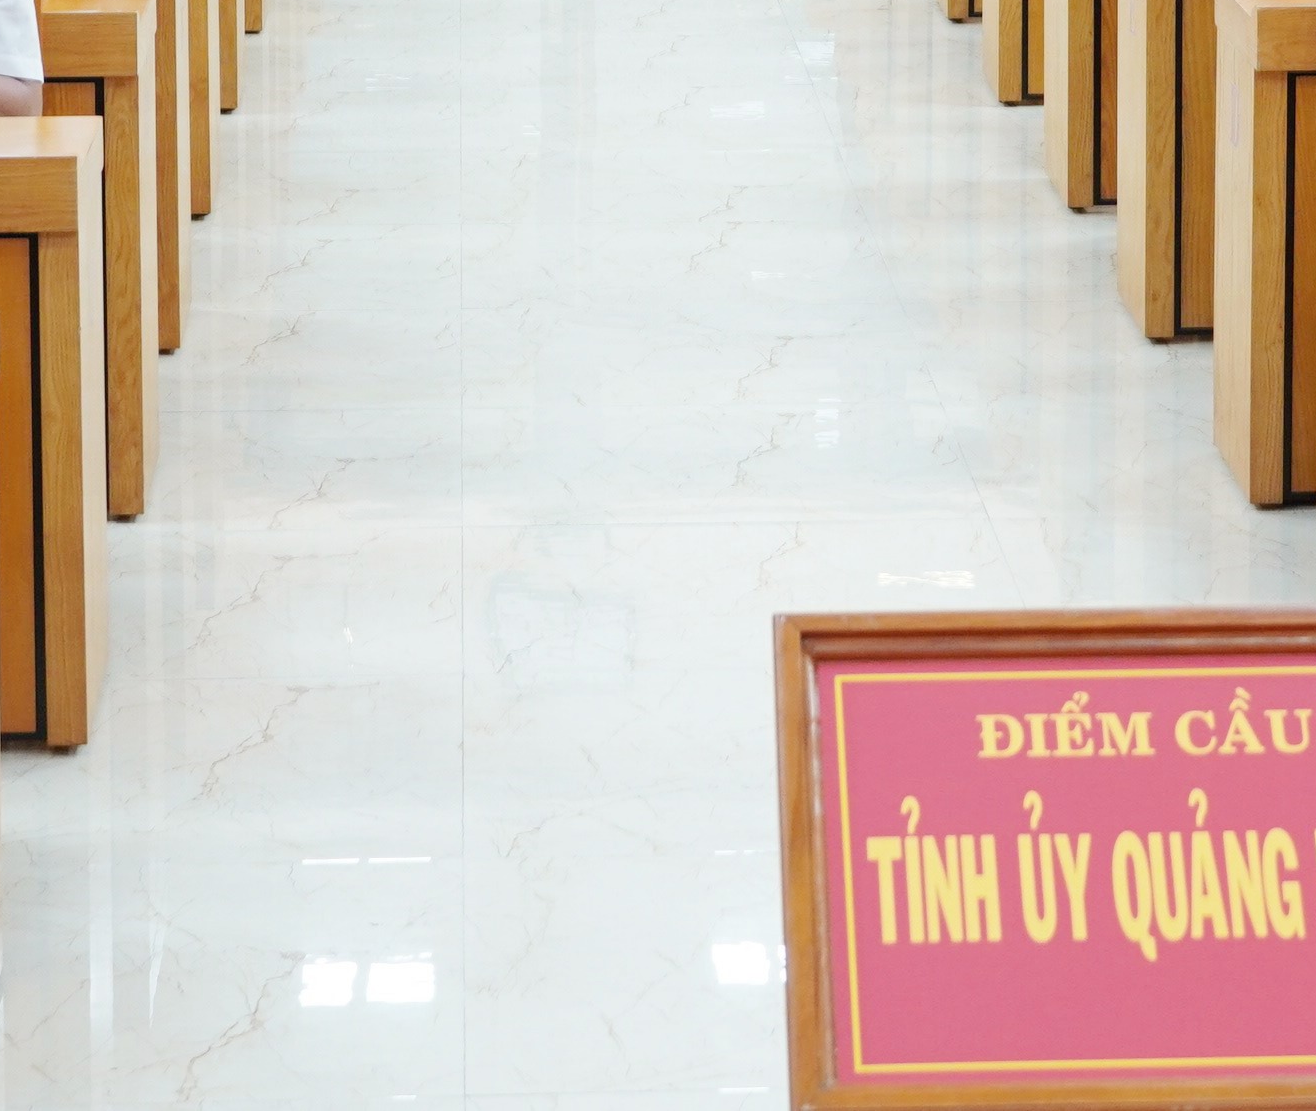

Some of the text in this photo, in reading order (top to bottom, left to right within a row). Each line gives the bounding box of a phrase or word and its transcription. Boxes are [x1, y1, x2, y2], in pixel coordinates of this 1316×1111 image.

[976, 687, 1312, 758] ĐIỂM CẦU
[866, 795, 1001, 944] TỈNH
[1018, 790, 1091, 943] ỦY
[1112, 788, 1306, 962] QUẢNG
